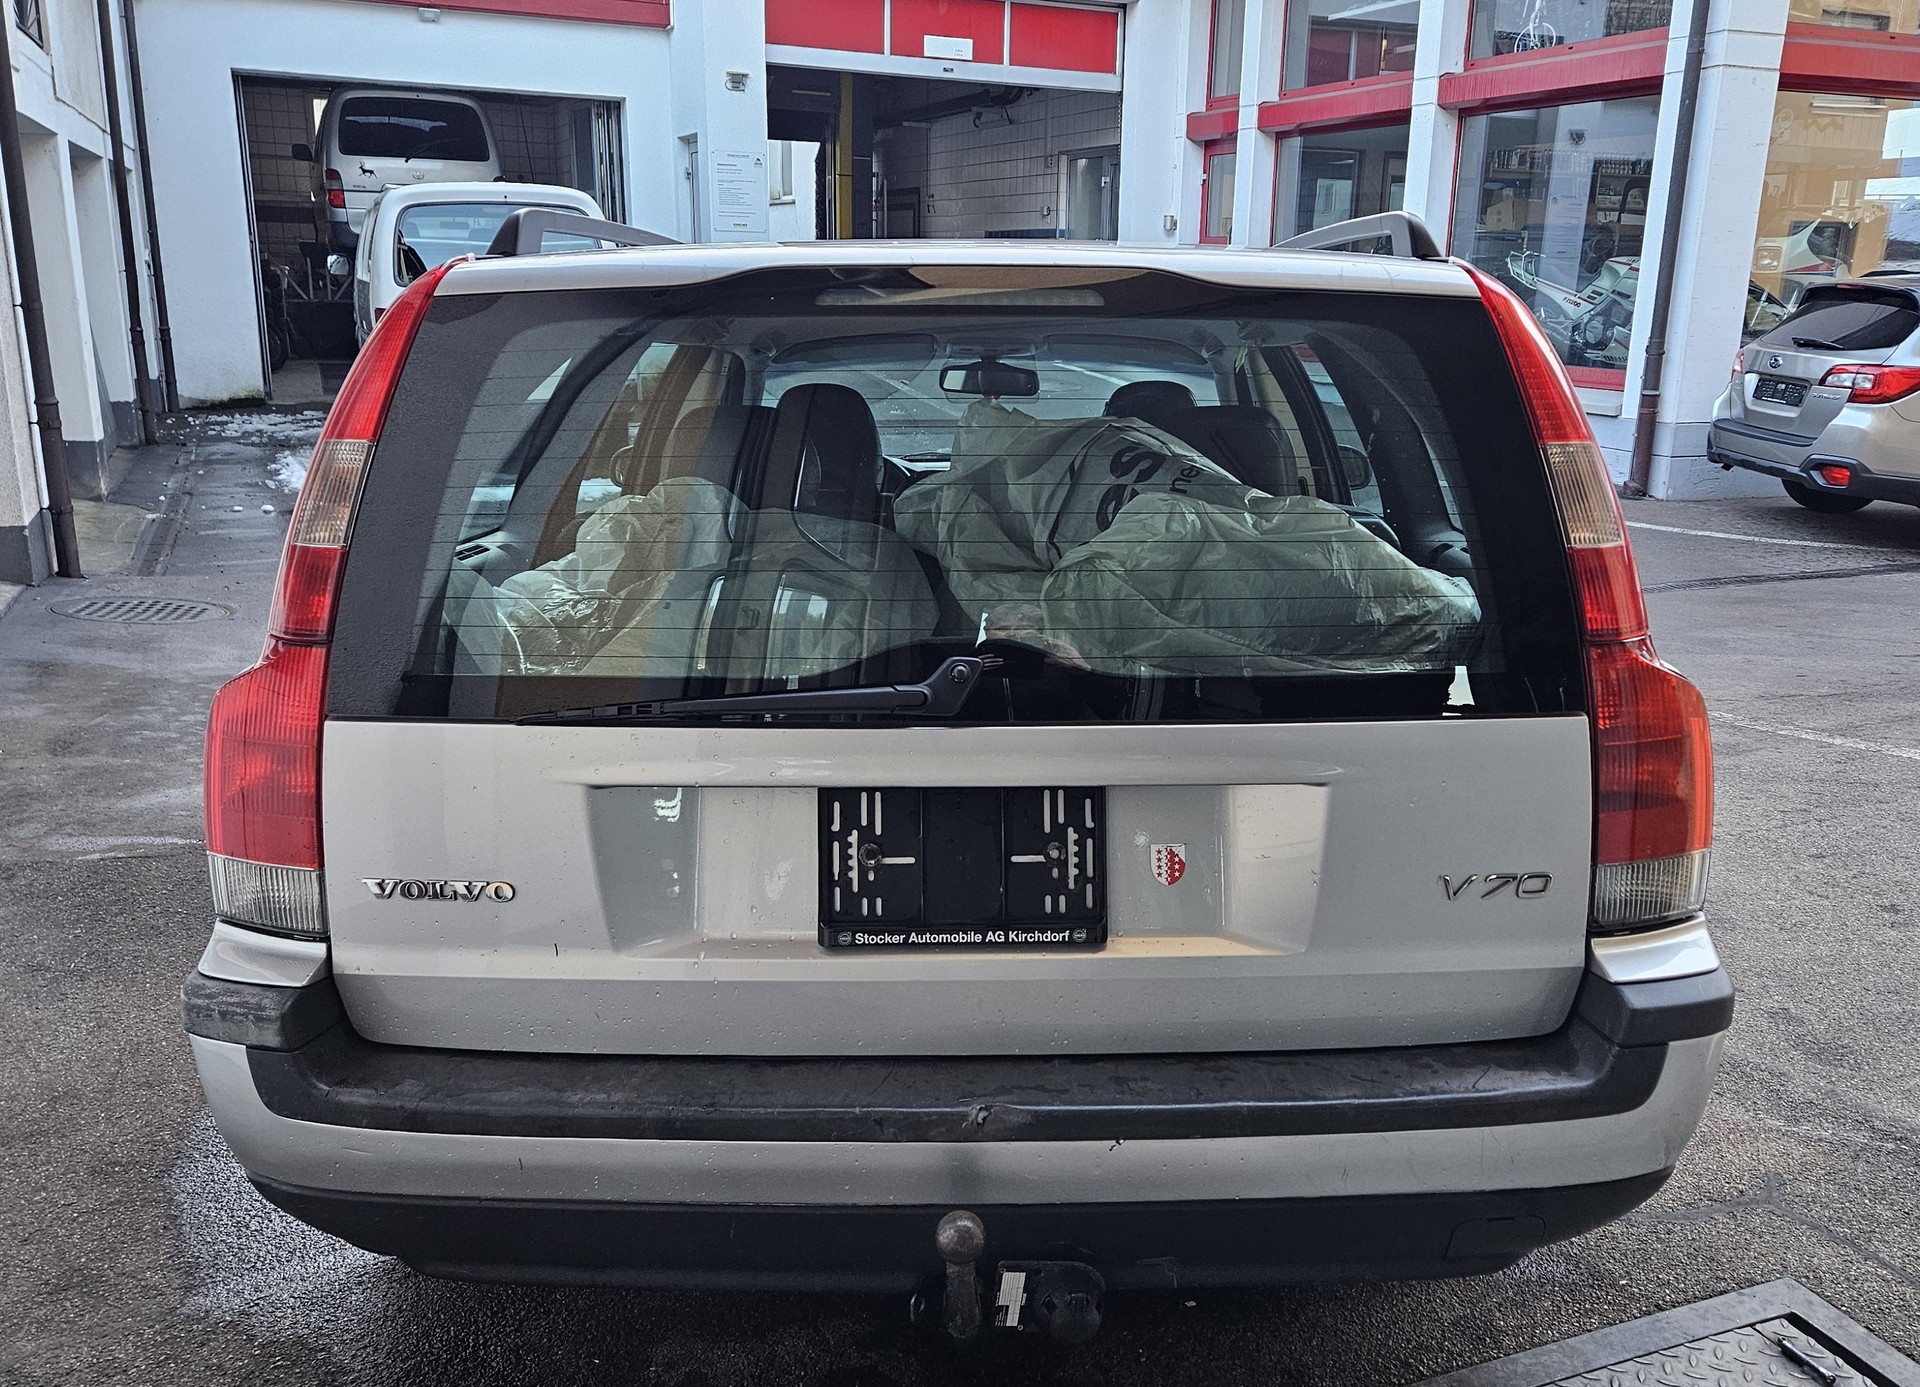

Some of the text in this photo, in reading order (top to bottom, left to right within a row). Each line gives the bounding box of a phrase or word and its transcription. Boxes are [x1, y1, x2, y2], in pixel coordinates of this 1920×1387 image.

[361, 877, 516, 903] VOLVO
[855, 930, 1070, 944] Stocker Automobile AG Kirchdorf
